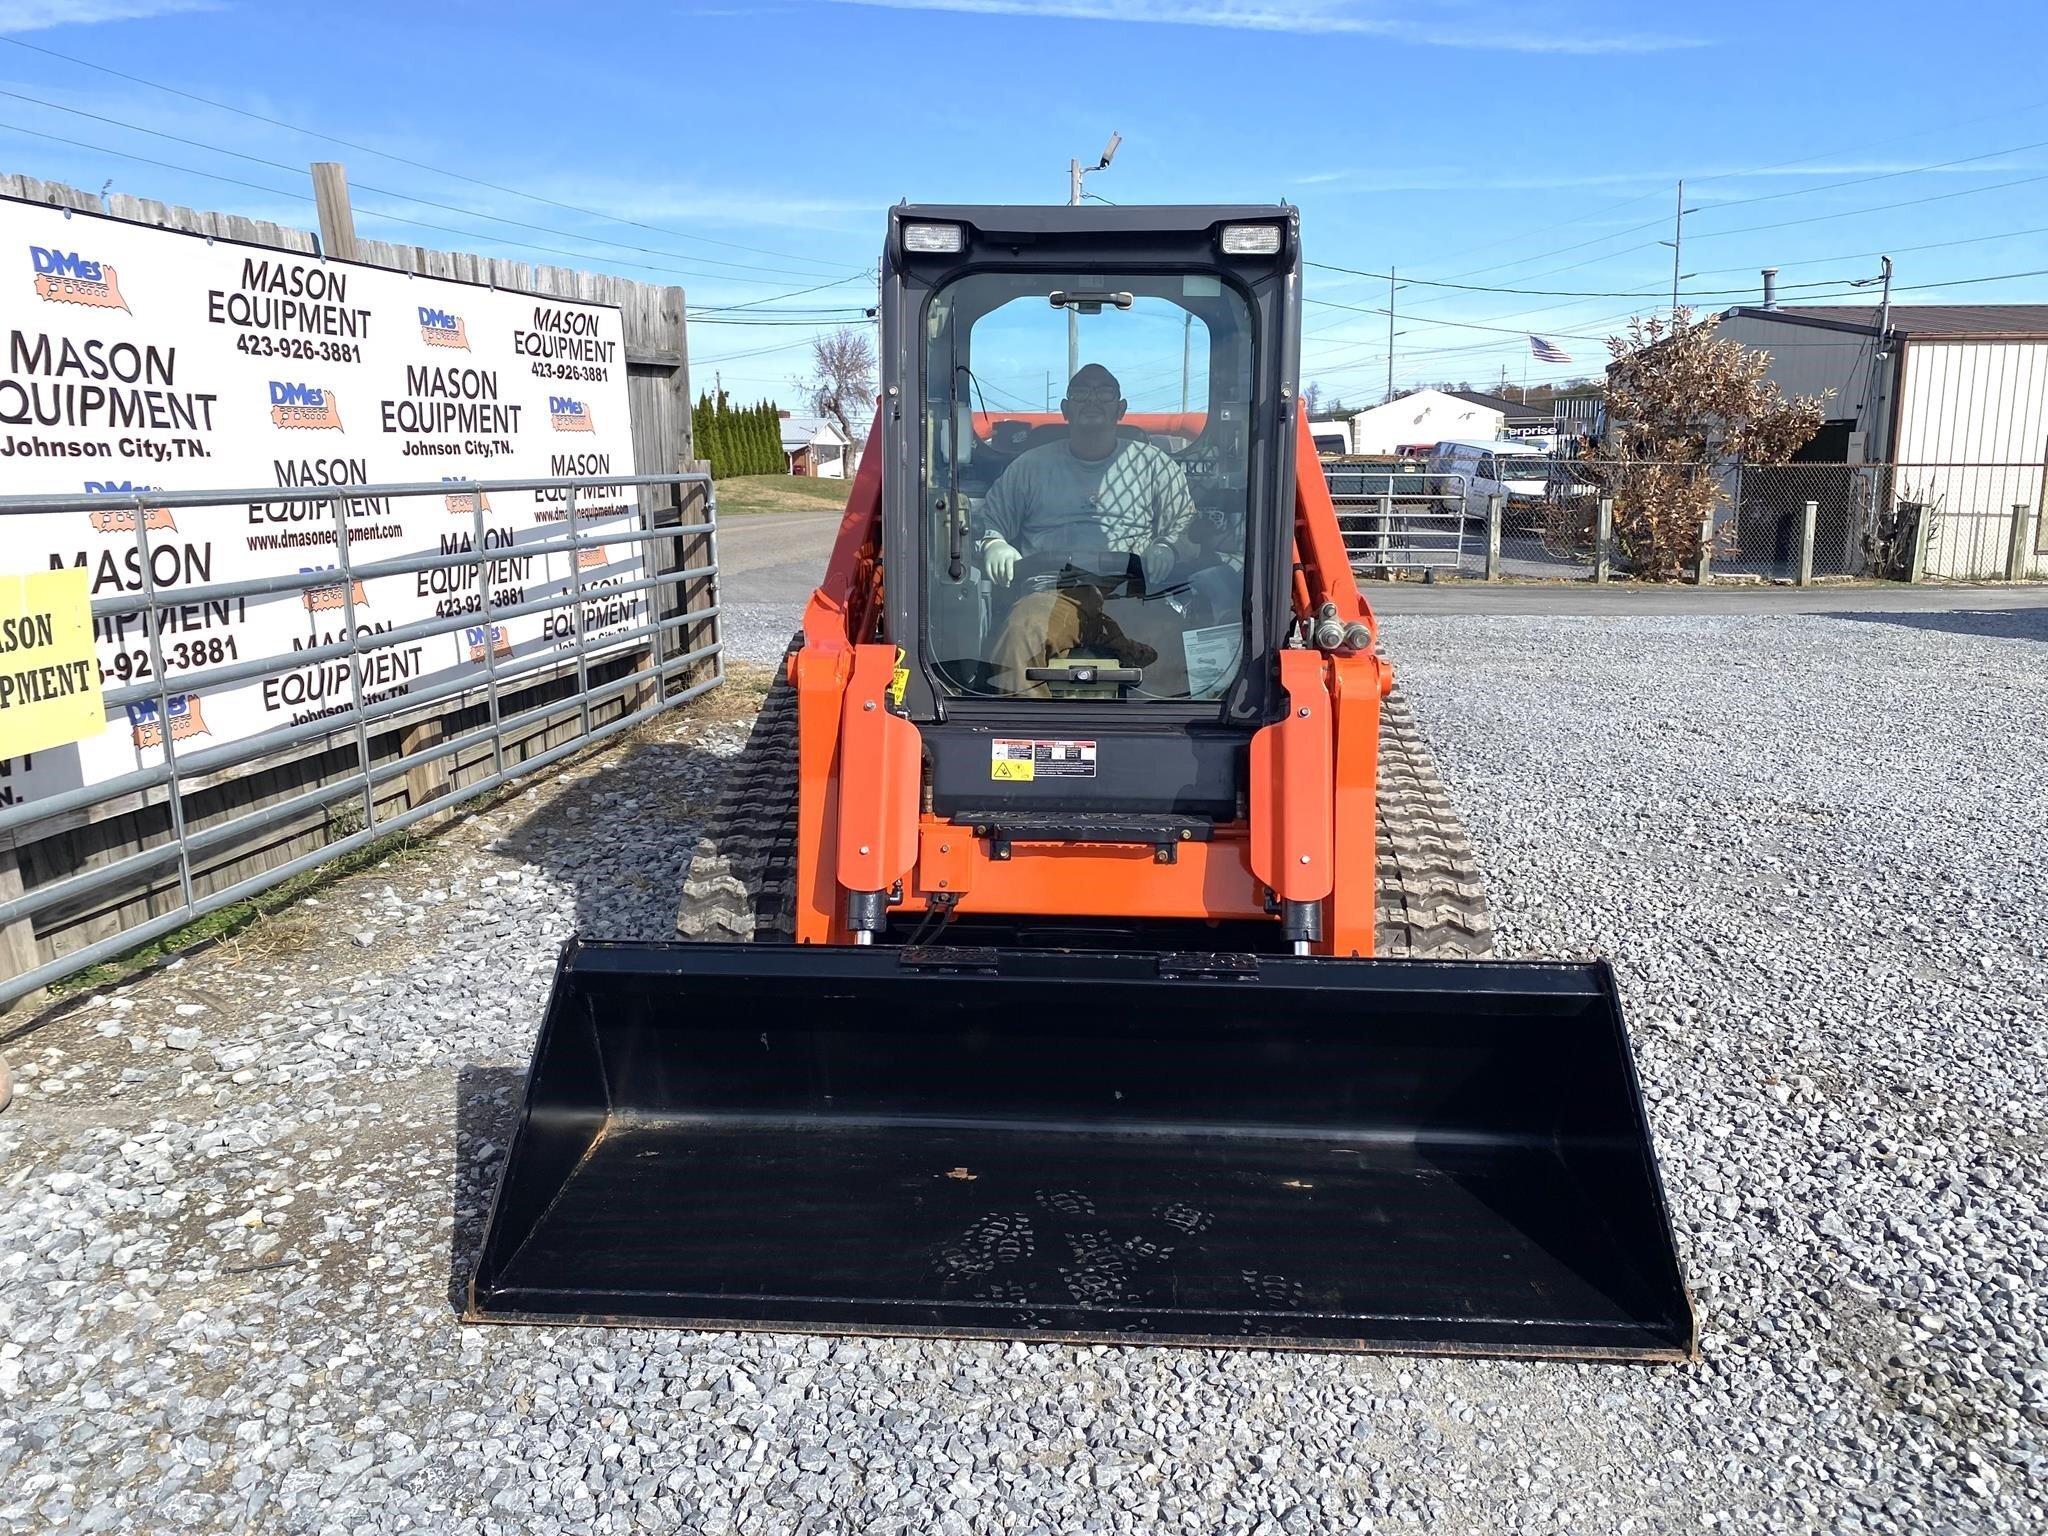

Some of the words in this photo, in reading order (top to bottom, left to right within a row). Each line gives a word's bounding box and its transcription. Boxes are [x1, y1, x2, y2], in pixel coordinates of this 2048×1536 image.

[241, 258, 346, 303] MASON
[208, 290, 371, 339] EQUIPMENT
[533, 307, 599, 337] MASON
[10, 330, 175, 386] MASON
[237, 333, 361, 363] 423-926-3881
[514, 330, 615, 363] EQUIPMENT
[407, 365, 497, 400] MASON
[531, 362, 608, 382] 423-926-3881
[0, 379, 217, 431] QUIPMENT
[381, 400, 521, 434] EQUIPMENT
[1, 435, 112, 458] Johnson
[1508, 426, 1557, 437] erprise
[402, 440, 461, 457] Johnson
[274, 459, 367, 488] MASON
[551, 454, 609, 476] MASON
[535, 485, 622, 503] EQUPMENT
[534, 503, 629, 522] www.dmanequipment.com
[247, 522, 403, 551] www.dmasoneqipment.com
[440, 526, 514, 556] MAON
[436, 586, 525, 619] 423-92-3881
[0, 613, 53, 654] SON
[93, 597, 246, 644] IPMENT
[97, 634, 238, 685] -92-3881
[0, 659, 90, 709] PMENT
